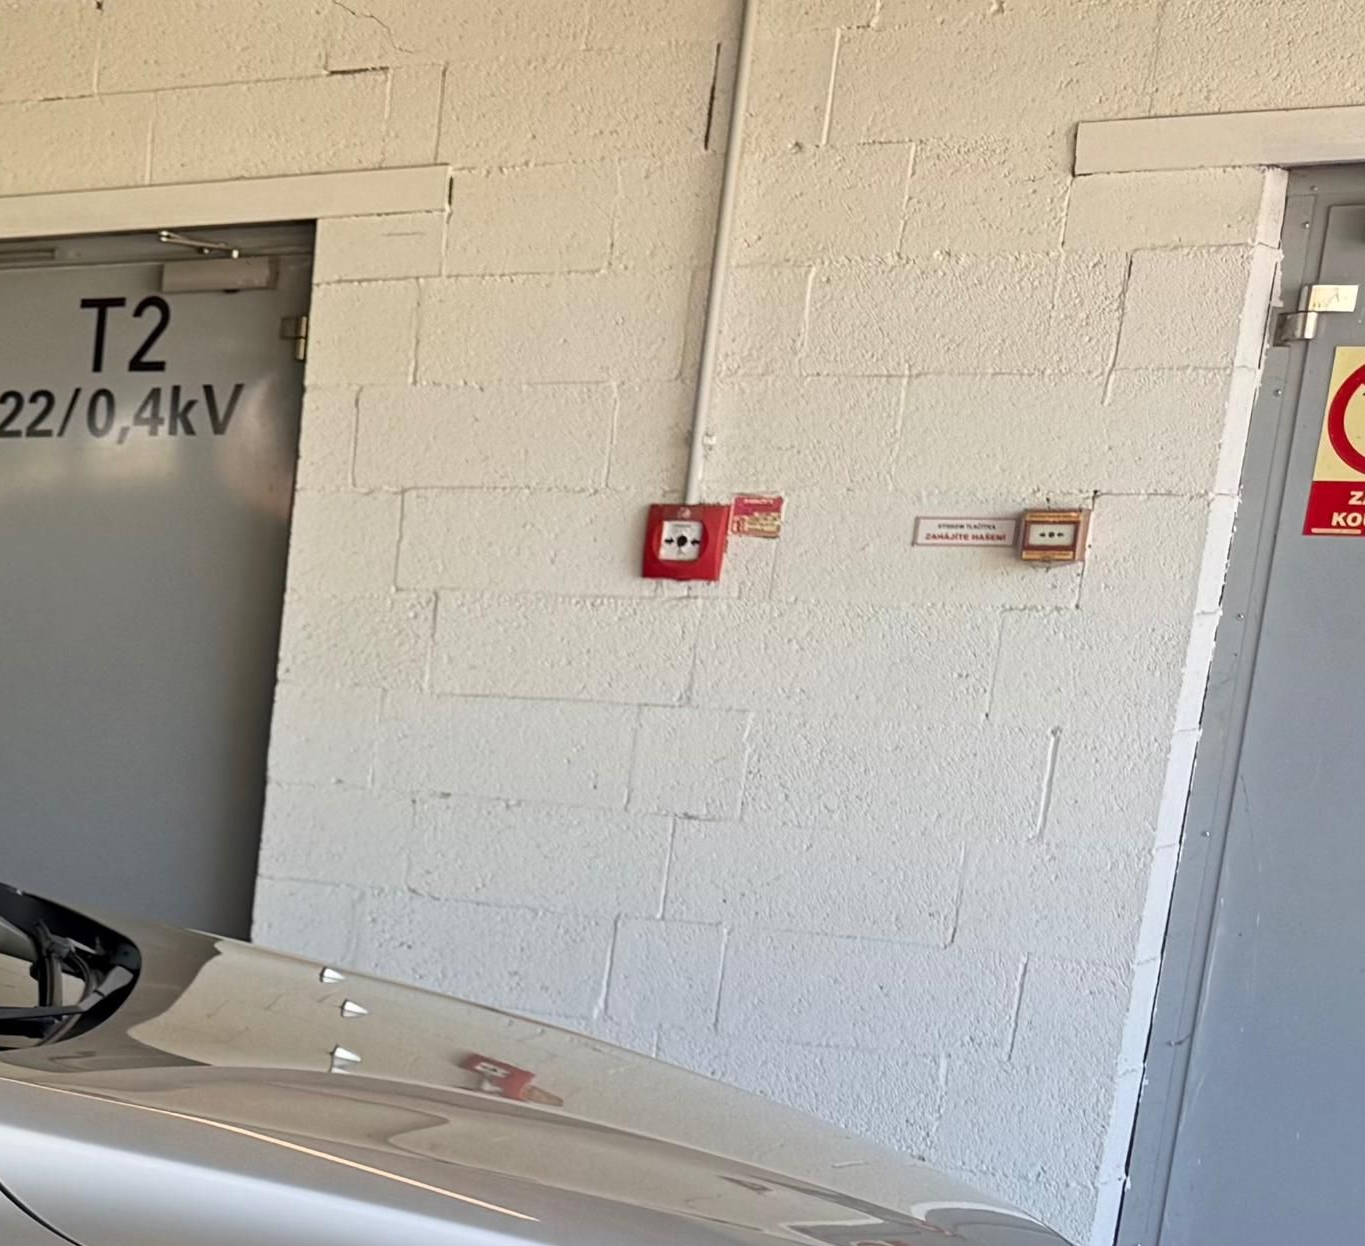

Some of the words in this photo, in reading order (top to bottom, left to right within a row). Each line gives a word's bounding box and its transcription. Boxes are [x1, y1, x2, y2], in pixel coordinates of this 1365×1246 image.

[80, 295, 171, 373] T2
[1348, 491, 1365, 506] Z
[1331, 511, 1365, 528] KO
